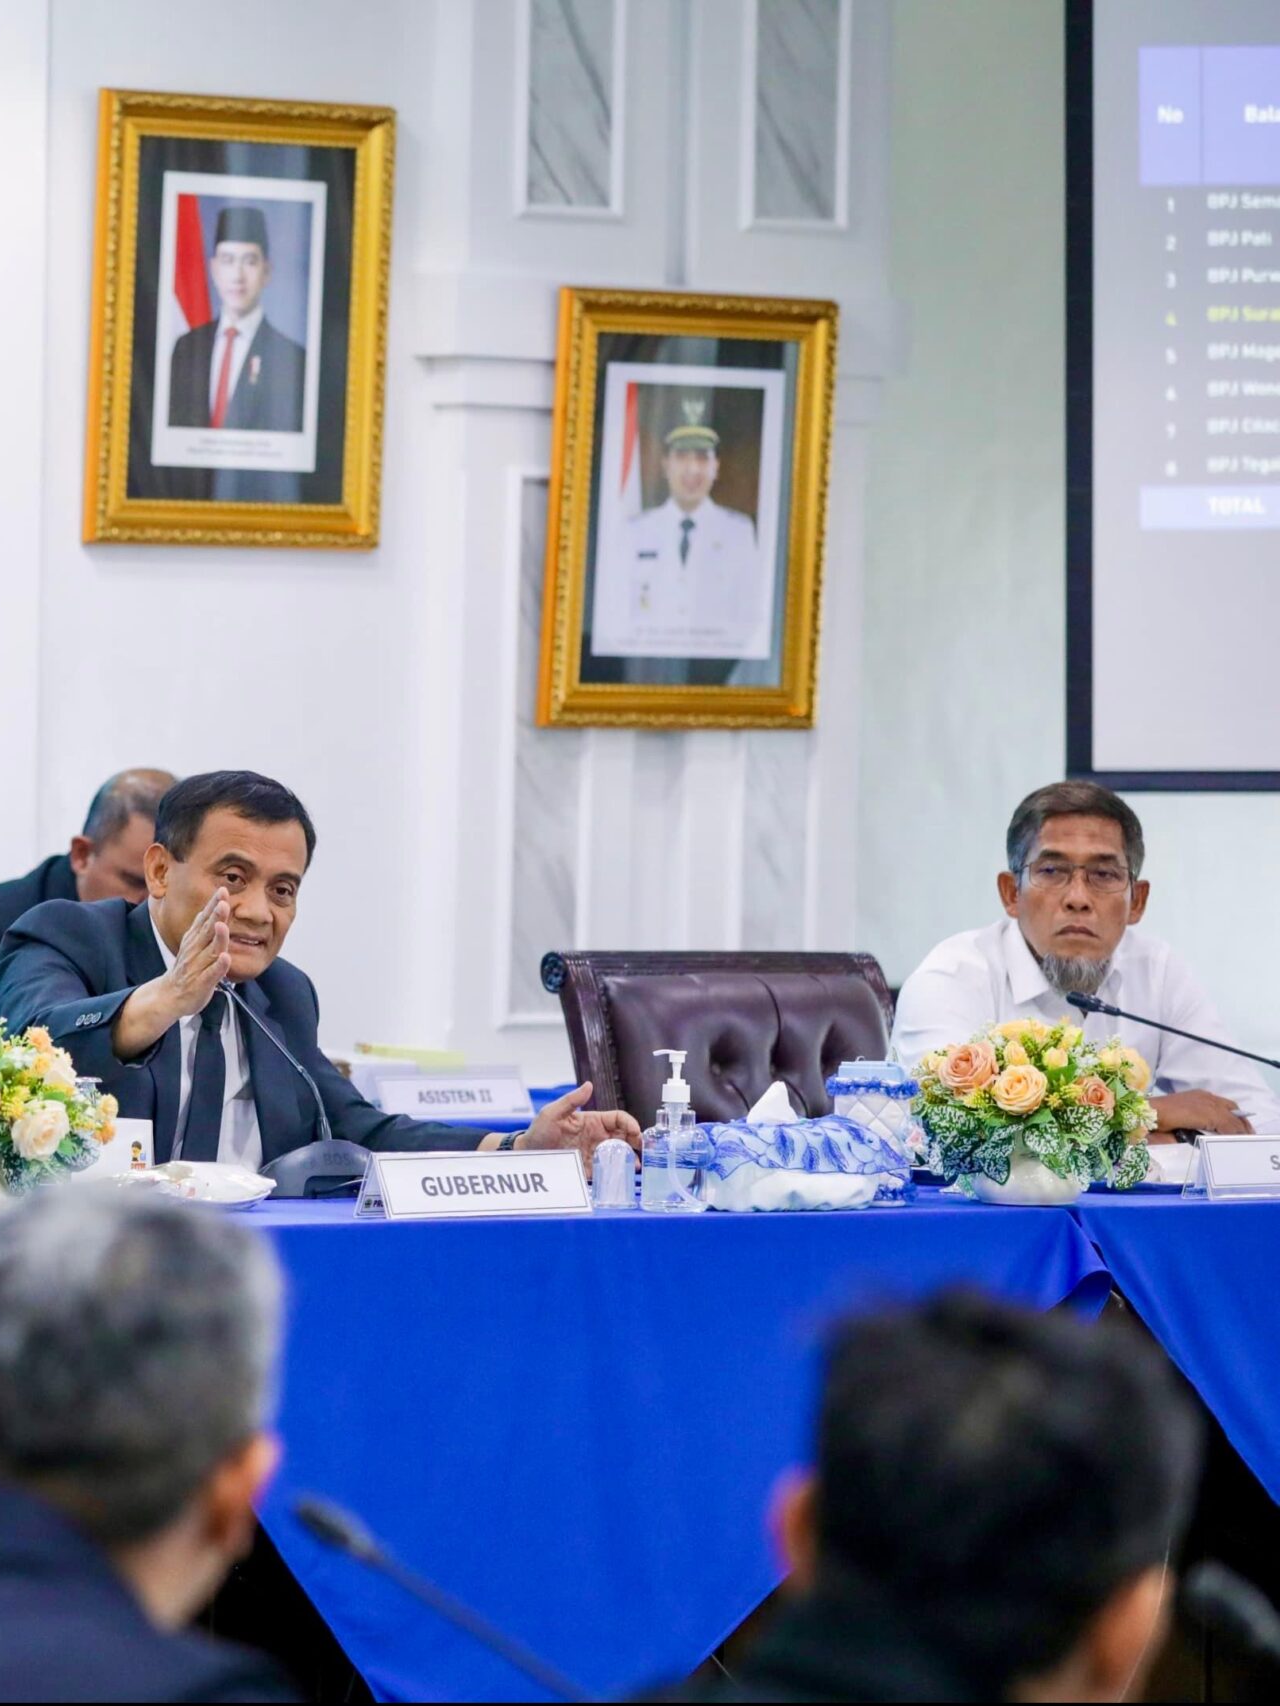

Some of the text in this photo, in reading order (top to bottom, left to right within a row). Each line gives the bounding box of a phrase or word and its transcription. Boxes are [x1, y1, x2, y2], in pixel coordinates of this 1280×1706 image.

[1157, 104, 1184, 124] No
[1208, 496, 1267, 516] TOTAL
[418, 1089, 493, 1105] ASISTEN II
[420, 1172, 549, 1197] GUBERNUR
